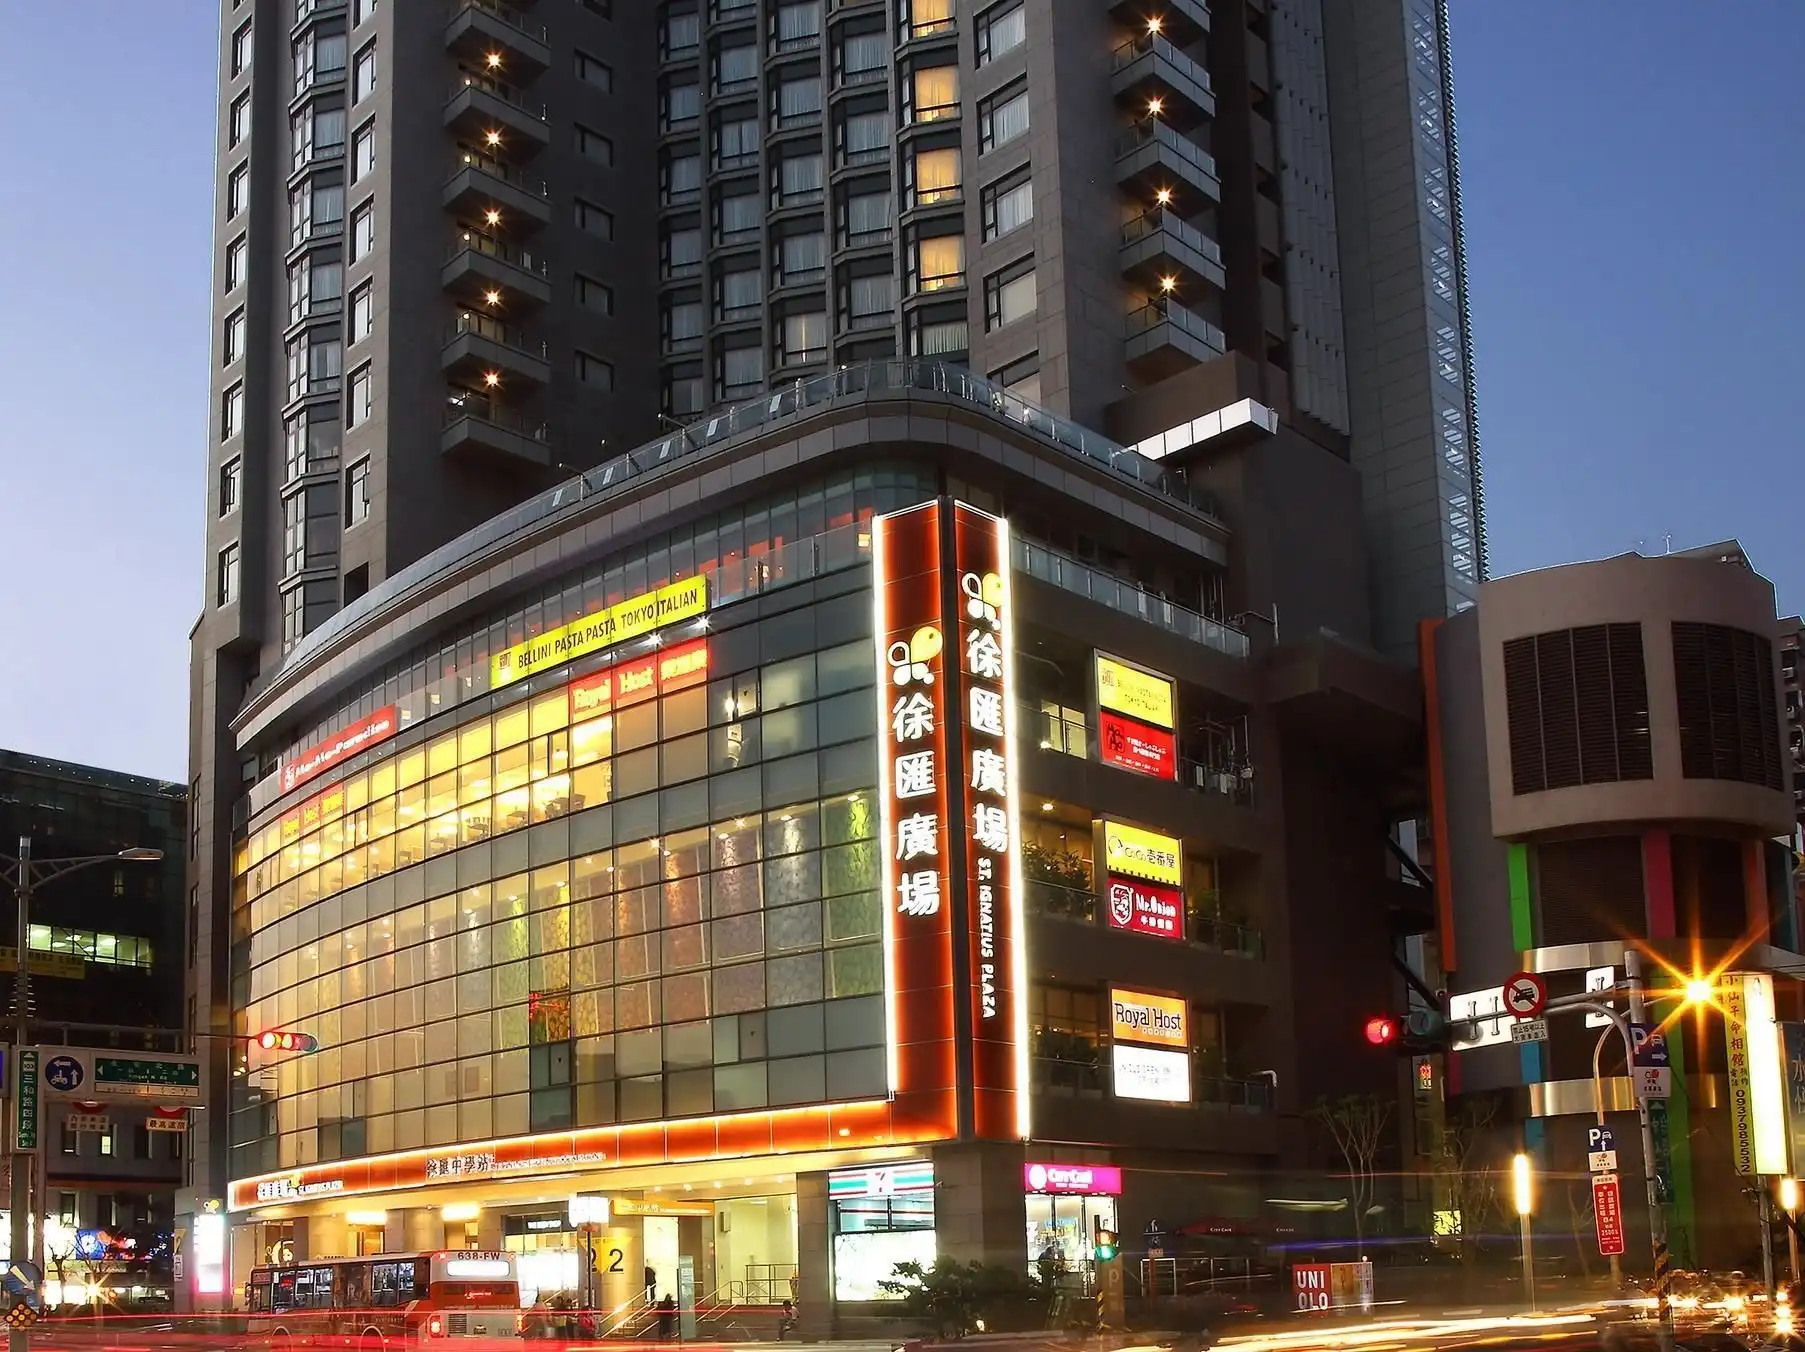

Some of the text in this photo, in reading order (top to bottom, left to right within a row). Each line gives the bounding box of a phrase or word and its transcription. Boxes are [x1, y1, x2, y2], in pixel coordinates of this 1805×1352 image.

[518, 588, 697, 668] BELLINI PASTA PASTA TOKYO ITALIAN
[966, 628, 1008, 853] 徐匯廣場
[892, 692, 940, 916] 徐匯廣場
[977, 857, 996, 1018] ST. IGNATIUS PLAZA
[1114, 1002, 1182, 1030] Royal Host
[1630, 1027, 1648, 1055] P
[1589, 1128, 1601, 1147] P
[1735, 1089, 1751, 1173] 0937985532
[457, 1252, 500, 1261] 638-FW
[609, 1248, 624, 1272] 2
[1297, 1271, 1325, 1289] UNI
